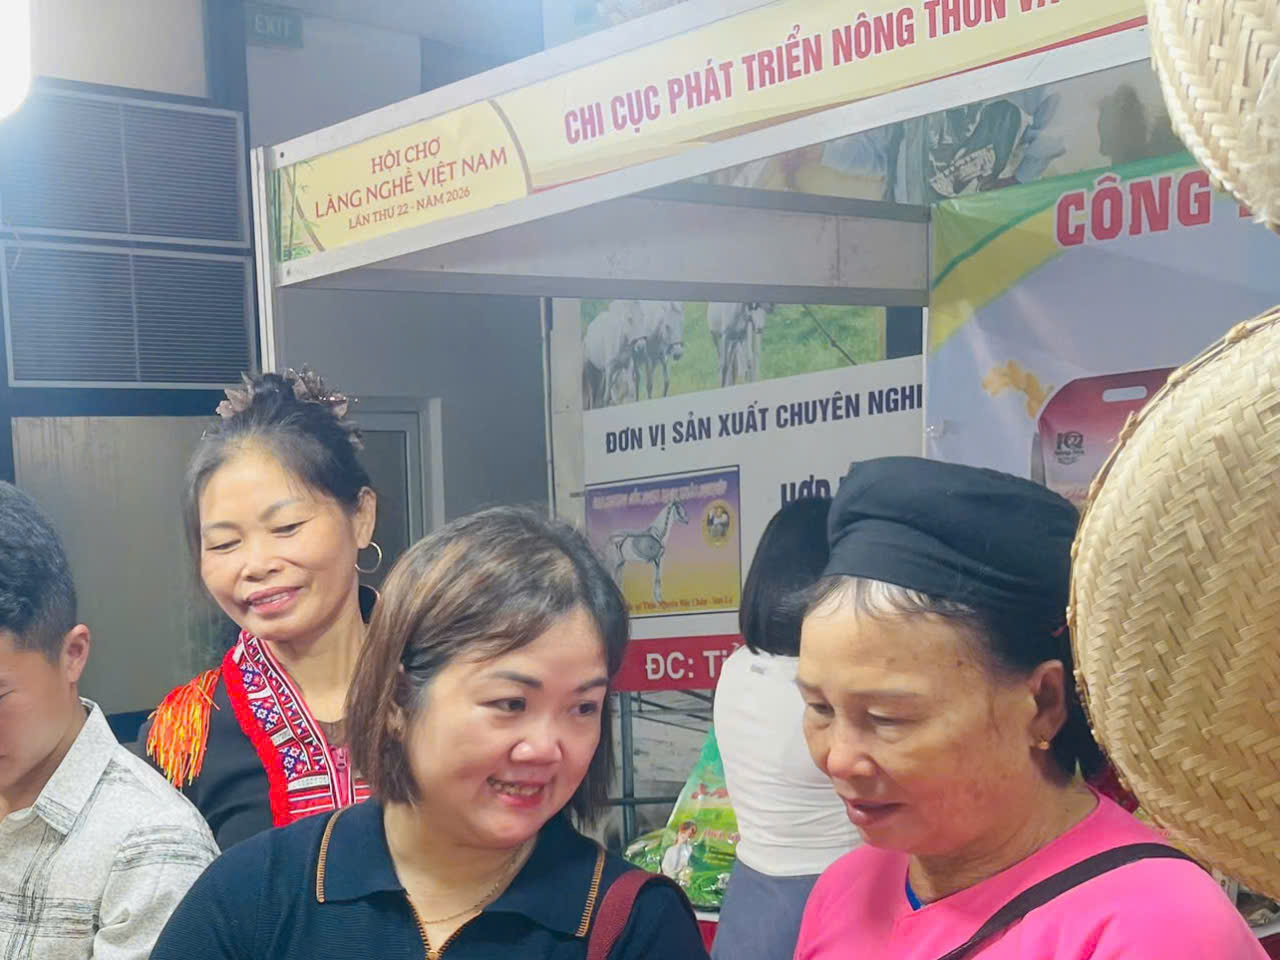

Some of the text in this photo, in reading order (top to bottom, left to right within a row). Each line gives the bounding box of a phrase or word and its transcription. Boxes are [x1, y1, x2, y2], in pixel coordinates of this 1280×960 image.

[564, 102, 604, 145] CHI
[610, 85, 660, 133] CỤC
[667, 58, 734, 114] PHÁT
[741, 24, 823, 91] TRIỂN
[832, 7, 915, 66] NÔNG
[315, 147, 508, 218] LÀNG NGHỀ VIỆT NAM
[371, 137, 441, 175] HỘI CHỢ
[397, 203, 409, 216] 22
[445, 186, 471, 205] 2026
[1057, 170, 1211, 247] CÔNG
[606, 427, 643, 454] ĐƠN
[649, 424, 666, 451] VỊ
[672, 411, 712, 444] SẢN
[718, 400, 769, 438] XUẤT
[776, 391, 860, 429] CHUYÊN
[645, 652, 694, 680] ĐC:
